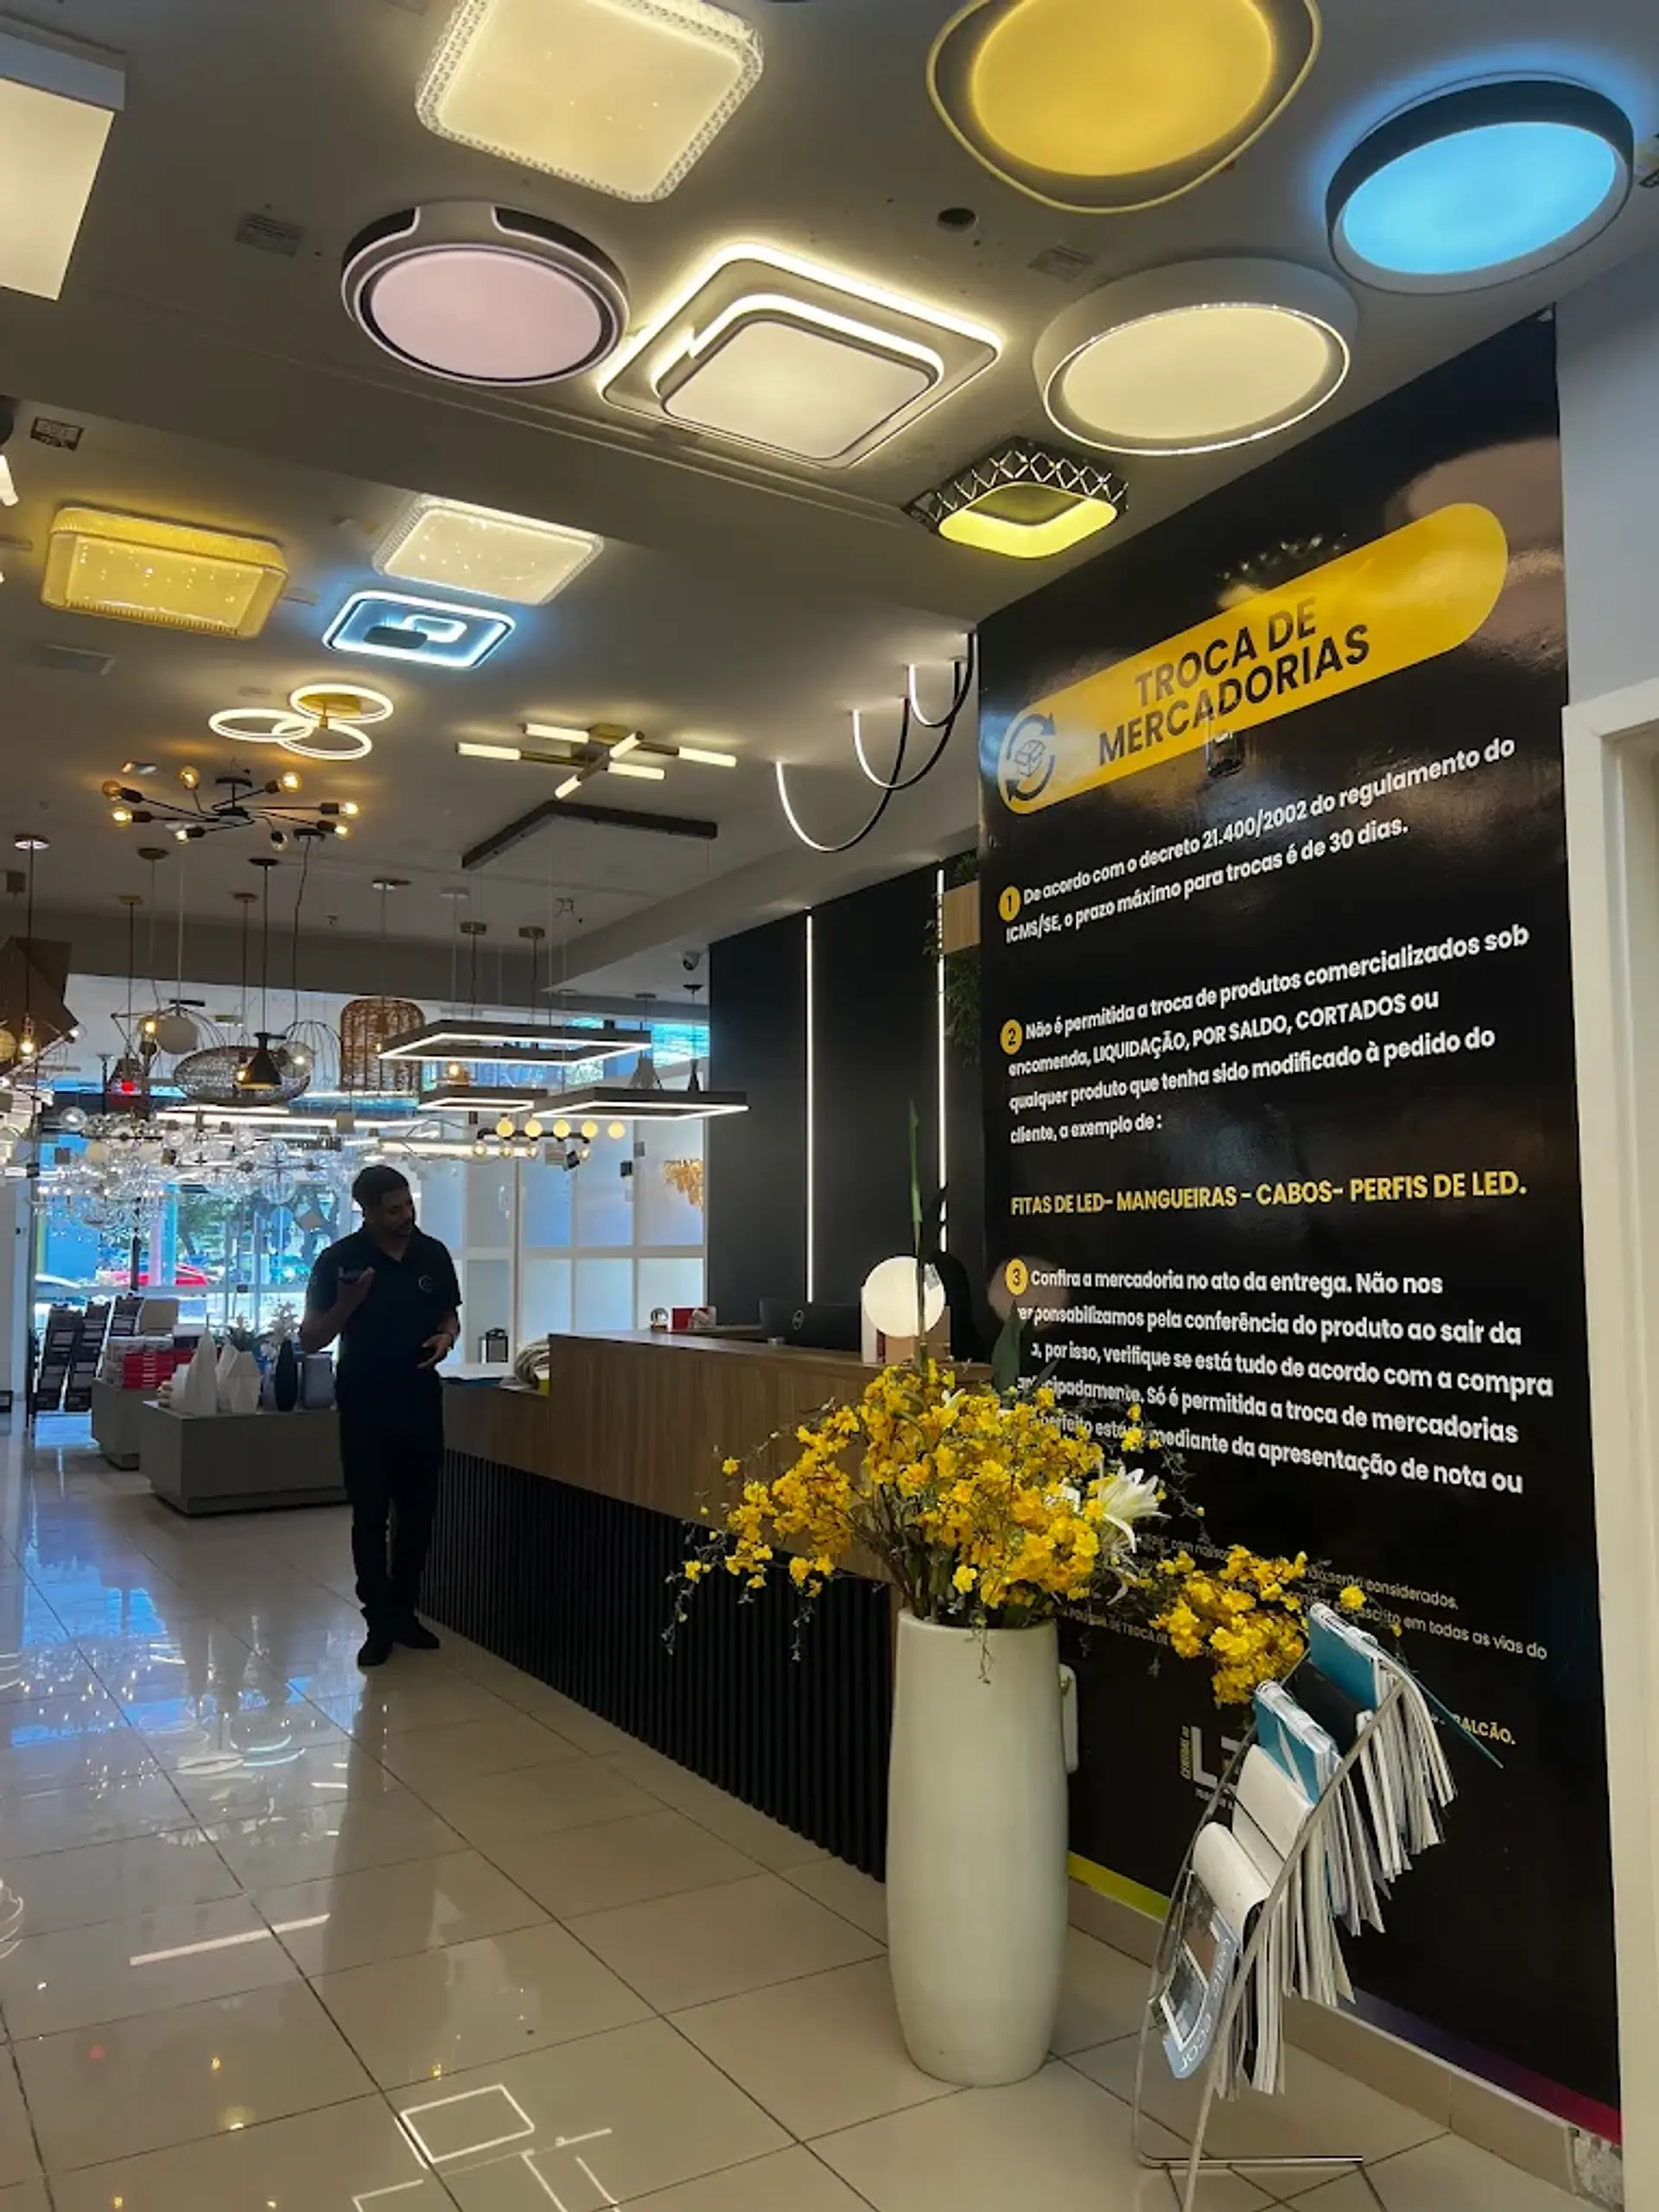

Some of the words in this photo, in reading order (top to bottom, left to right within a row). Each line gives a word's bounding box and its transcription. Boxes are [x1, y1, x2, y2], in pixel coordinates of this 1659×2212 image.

[1135, 627, 1258, 707] TROCA
[1268, 596, 1317, 650] DE
[1098, 623, 1370, 766] MERCADORIAS
[1024, 887, 1041, 906] De
[1042, 870, 1091, 899] acordo
[1092, 862, 1124, 884] com
[1127, 858, 1137, 873] o
[1138, 838, 1200, 869] decreto
[1202, 800, 1308, 850] 21.400/2002
[1310, 792, 1336, 817] do
[1339, 750, 1481, 808] regulamento
[1484, 737, 1516, 763] do
[1006, 910, 1062, 944] ICMS/SE,
[1065, 914, 1073, 928] o
[1075, 903, 1116, 931] prazo
[1116, 881, 1181, 913] máximo
[1184, 870, 1224, 900] para
[1225, 852, 1282, 882] trocas
[1286, 842, 1298, 866] é
[1300, 836, 1325, 861] de
[1328, 828, 1353, 854] 30
[1357, 817, 1410, 846] dias.
[1025, 1020, 1052, 1041] Não
[1054, 1015, 1063, 1034] é
[1064, 1003, 1135, 1039] permitida
[1137, 1004, 1148, 1020] a
[1150, 993, 1194, 1017] troca
[1196, 987, 1217, 1007] de
[1219, 972, 1302, 1009] produtos
[1304, 937, 1481, 988] comercializados
[1484, 924, 1530, 951] sob
[1008, 1048, 1091, 1077] encomenda,
[1092, 1031, 1191, 1064] LIQUIDAÇÃO,
[1192, 1025, 1227, 1048] POR
[1228, 1014, 1293, 1041] SALDO,
[1295, 993, 1407, 1032] CORTADOS
[1409, 991, 1440, 1013] ou
[1008, 1088, 1069, 1116] qualquer
[1071, 1080, 1128, 1107] produto
[1129, 1076, 1160, 1100] que
[1160, 1068, 1210, 1090] tenha
[1211, 1061, 1249, 1084] sido
[1252, 1046, 1363, 1080] modificado
[1365, 1040, 1380, 1064] à
[1383, 1031, 1462, 1068] pedido
[1464, 1026, 1496, 1049] do
[1010, 1124, 1058, 1145] cliente,
[1058, 1125, 1069, 1139] a
[1071, 1114, 1133, 1140] exemplo
[1010, 1196, 1052, 1216] FITAS
[1054, 1193, 1074, 1213] DE
[1116, 1185, 1237, 1211] MANGUEIRAS
[1350, 1175, 1428, 1202] PERFIS
[1433, 1173, 1466, 1199] DE
[1471, 1170, 1528, 1197] LED.
[1030, 1268, 1081, 1288] Confira
[1082, 1272, 1092, 1287] a
[1094, 1268, 1184, 1290] mercadoria
[1186, 1274, 1209, 1291] no
[1211, 1271, 1241, 1292] ato
[1243, 1270, 1268, 1292] da
[1270, 1271, 1353, 1300] entrega.
[1356, 1270, 1400, 1294] Não
[1402, 1274, 1444, 1294] nos
[1147, 1308, 1183, 1332] pela
[1184, 1309, 1289, 1335] conferência
[1293, 1313, 1318, 1336] do
[1320, 1316, 1404, 1343] produto
[1407, 1322, 1437, 1341] ao
[1440, 1319, 1485, 1344] sair
[1488, 1320, 1522, 1345] da
[1045, 1343, 1068, 1363] por
[1069, 1340, 1102, 1364] isso,
[1102, 1344, 1172, 1371] verifique
[1173, 1352, 1192, 1369] se
[1194, 1350, 1232, 1372] está
[1236, 1353, 1279, 1376] tudo
[1281, 1356, 1305, 1378] de
[1307, 1362, 1381, 1384] acordo
[1383, 1366, 1433, 1389] com
[1437, 1370, 1452, 1389] a
[1456, 1373, 1554, 1402] compra
[1147, 1386, 1166, 1407] Só
[1168, 1385, 1179, 1408] é
[1181, 1392, 1268, 1417] permitida
[1270, 1402, 1283, 1420] a
[1285, 1399, 1338, 1425] troca
[1341, 1404, 1368, 1427] de
[1371, 1411, 1520, 1444] mercadorias
[1231, 1435, 1255, 1458] da
[1258, 1441, 1397, 1480] apresentação
[1401, 1457, 1430, 1480] de
[1433, 1464, 1487, 1489] nota
[1491, 1473, 1524, 1494] ou
[1365, 1577, 1459, 1611] considerados.
[1403, 1616, 1427, 1631] em
[1428, 1619, 1470, 1642] todas
[1472, 1631, 1491, 1646] as
[1492, 1636, 1524, 1654] vias
[1526, 1641, 1548, 1660] do
